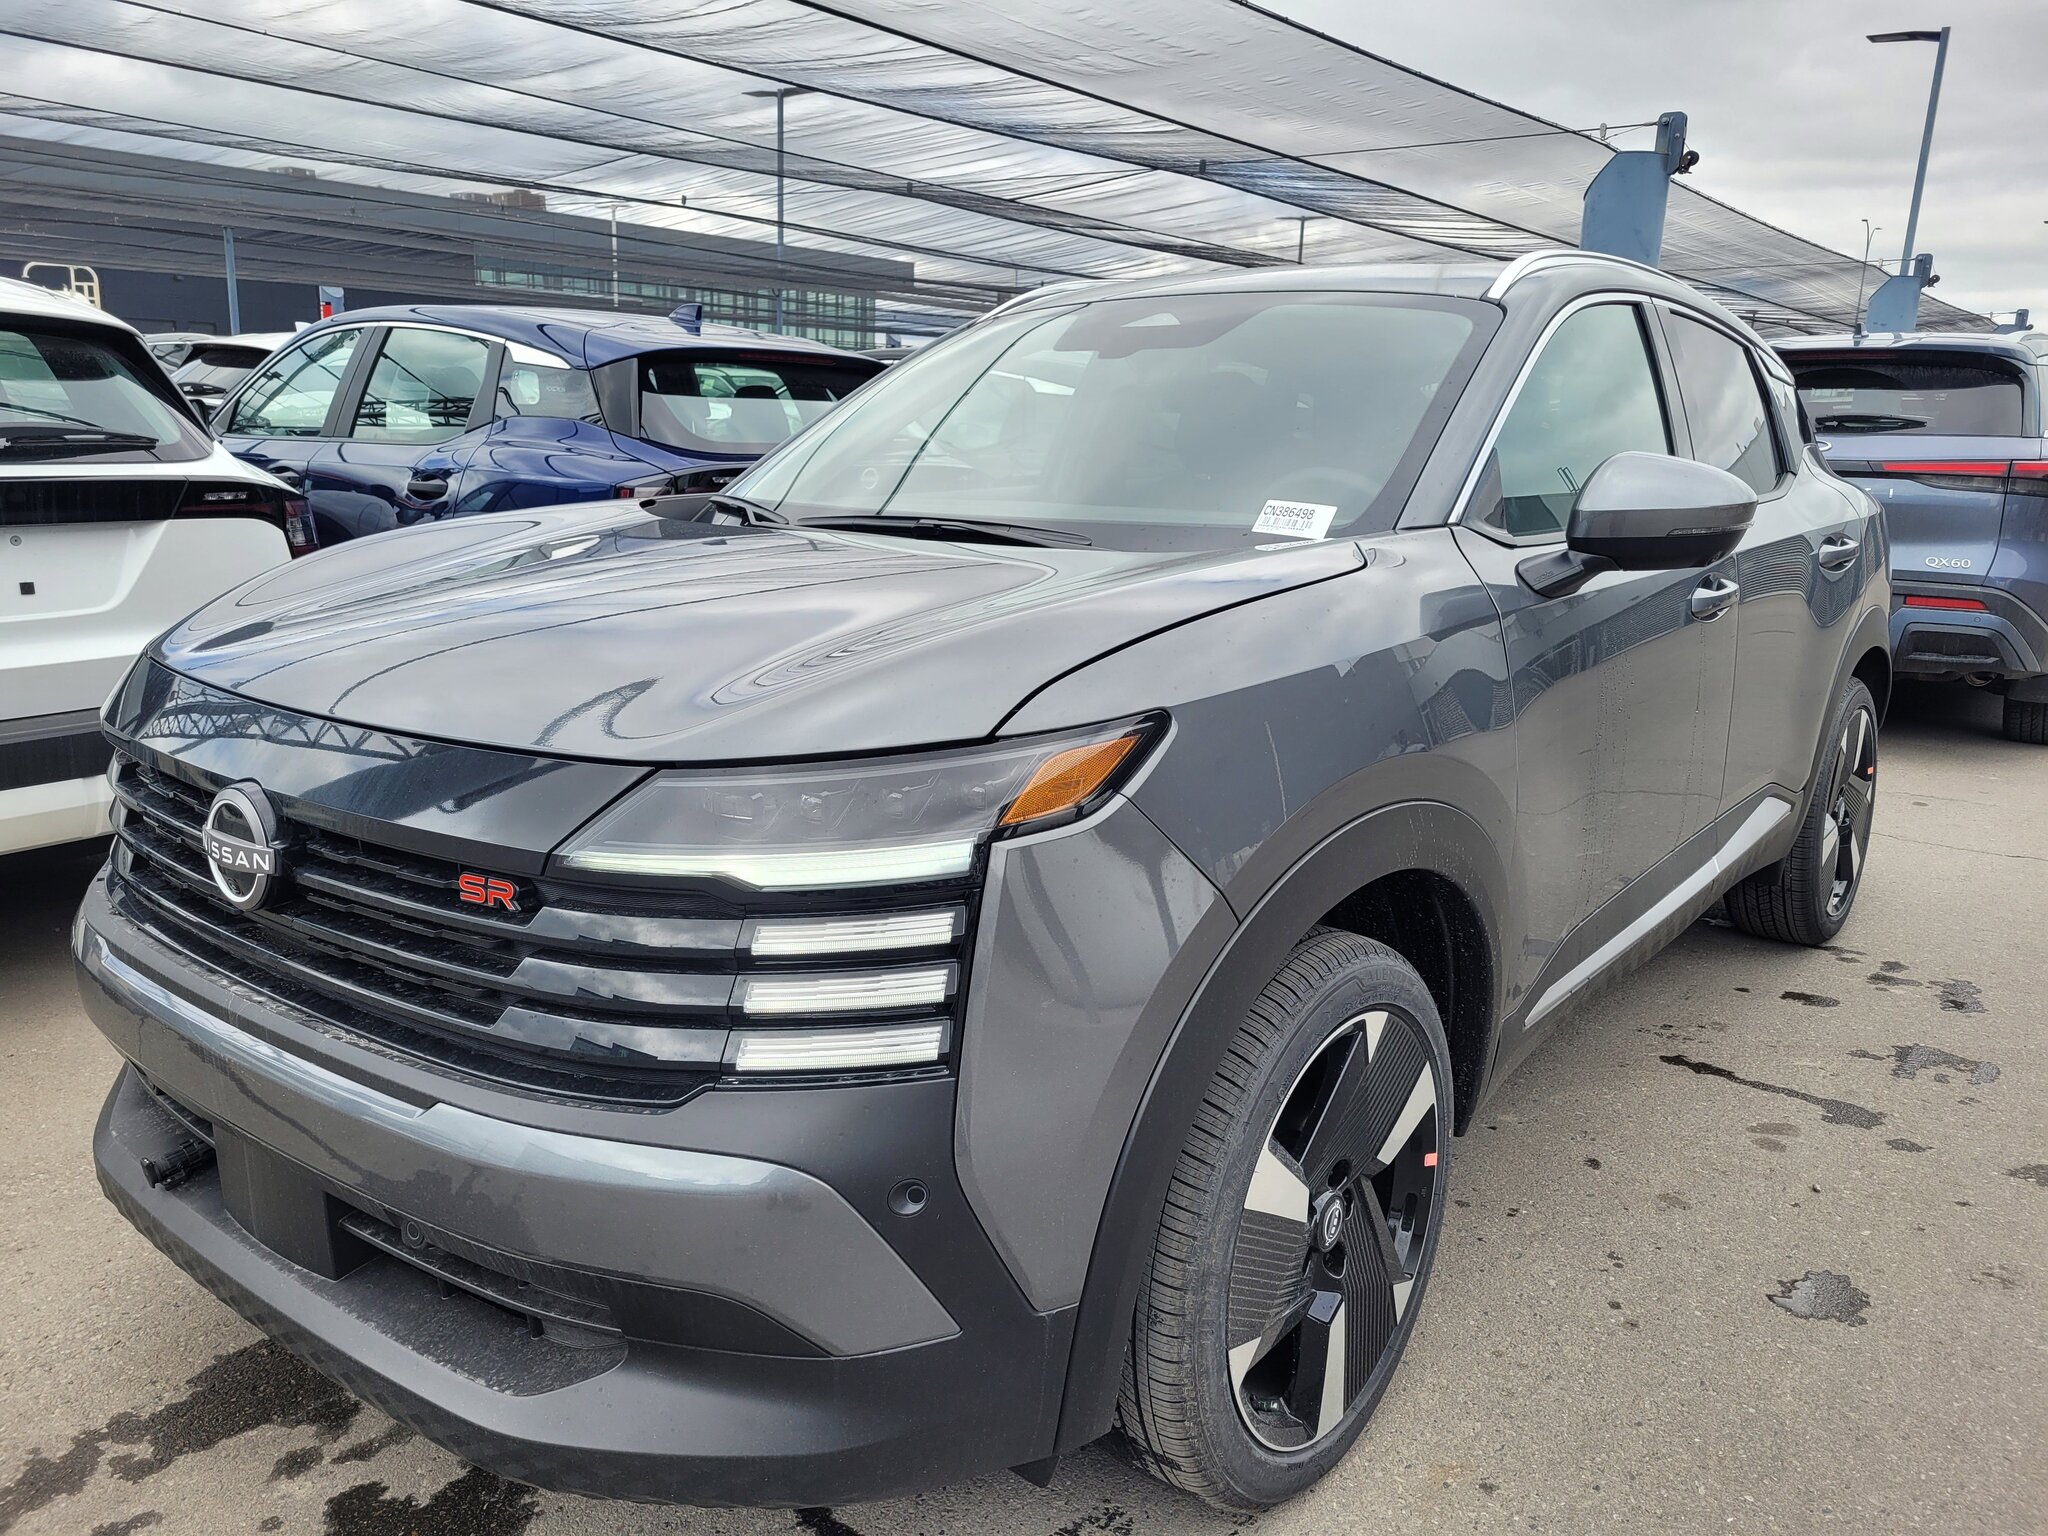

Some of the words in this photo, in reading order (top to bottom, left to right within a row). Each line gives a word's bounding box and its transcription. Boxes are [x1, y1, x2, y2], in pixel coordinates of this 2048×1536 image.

[1263, 504, 1316, 520] CN386498
[1925, 556, 1971, 569] QX60
[202, 828, 270, 871] NISSAN
[459, 873, 517, 911] SR
